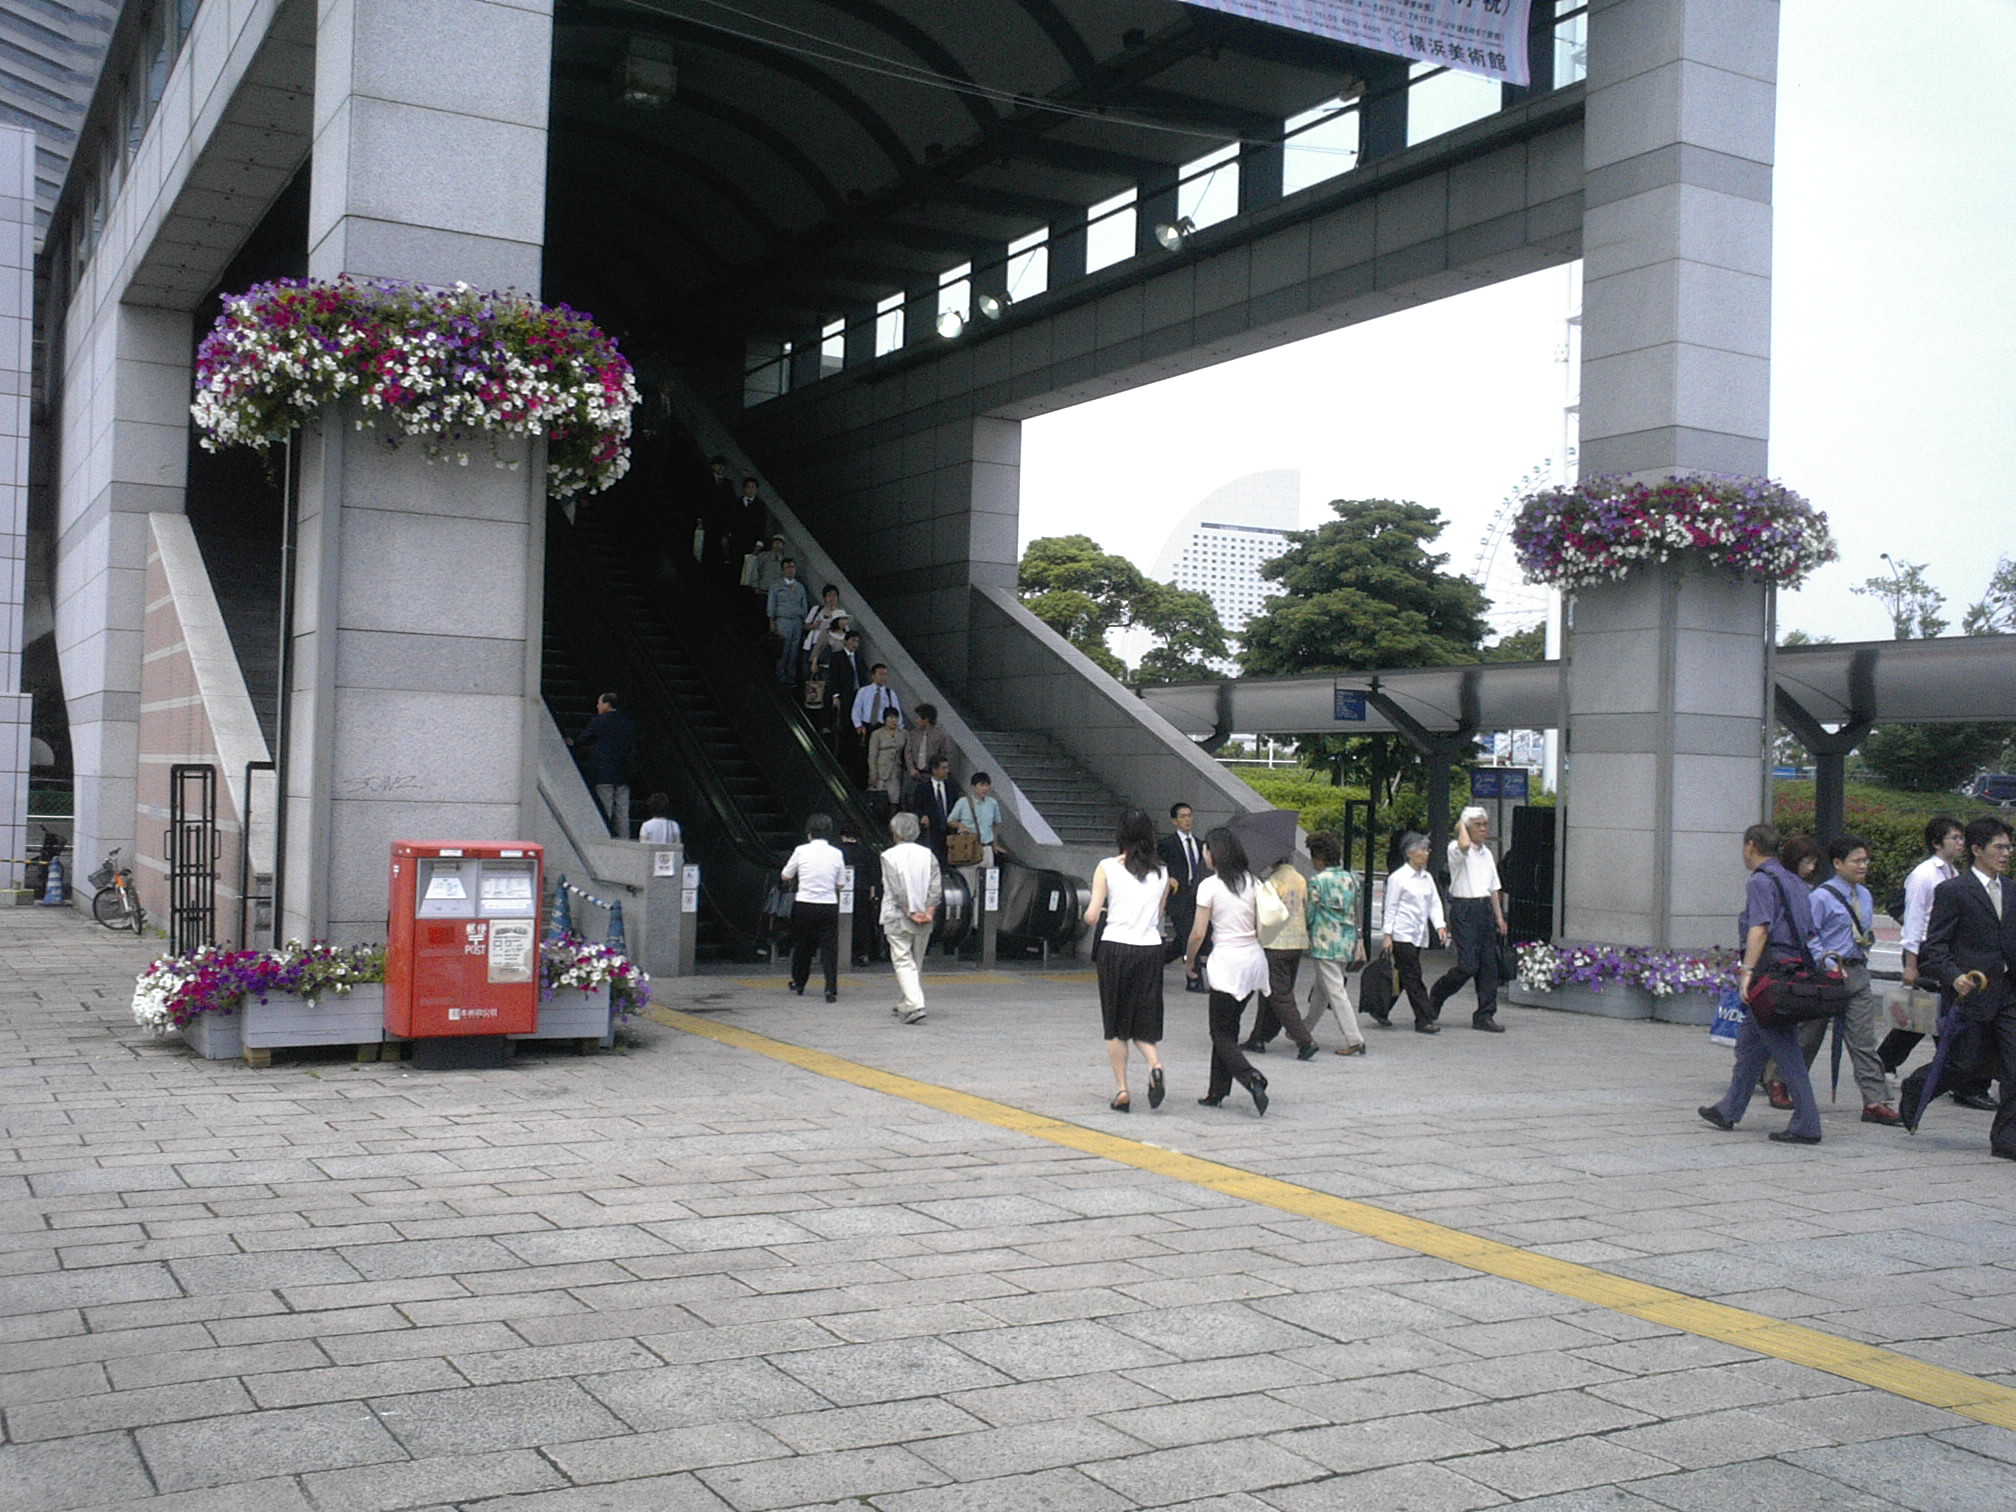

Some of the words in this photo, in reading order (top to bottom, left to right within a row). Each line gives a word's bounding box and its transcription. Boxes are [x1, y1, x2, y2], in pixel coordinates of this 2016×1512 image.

[1408, 32, 1507, 72] 横浜美術館
[464, 944, 487, 956] POST
